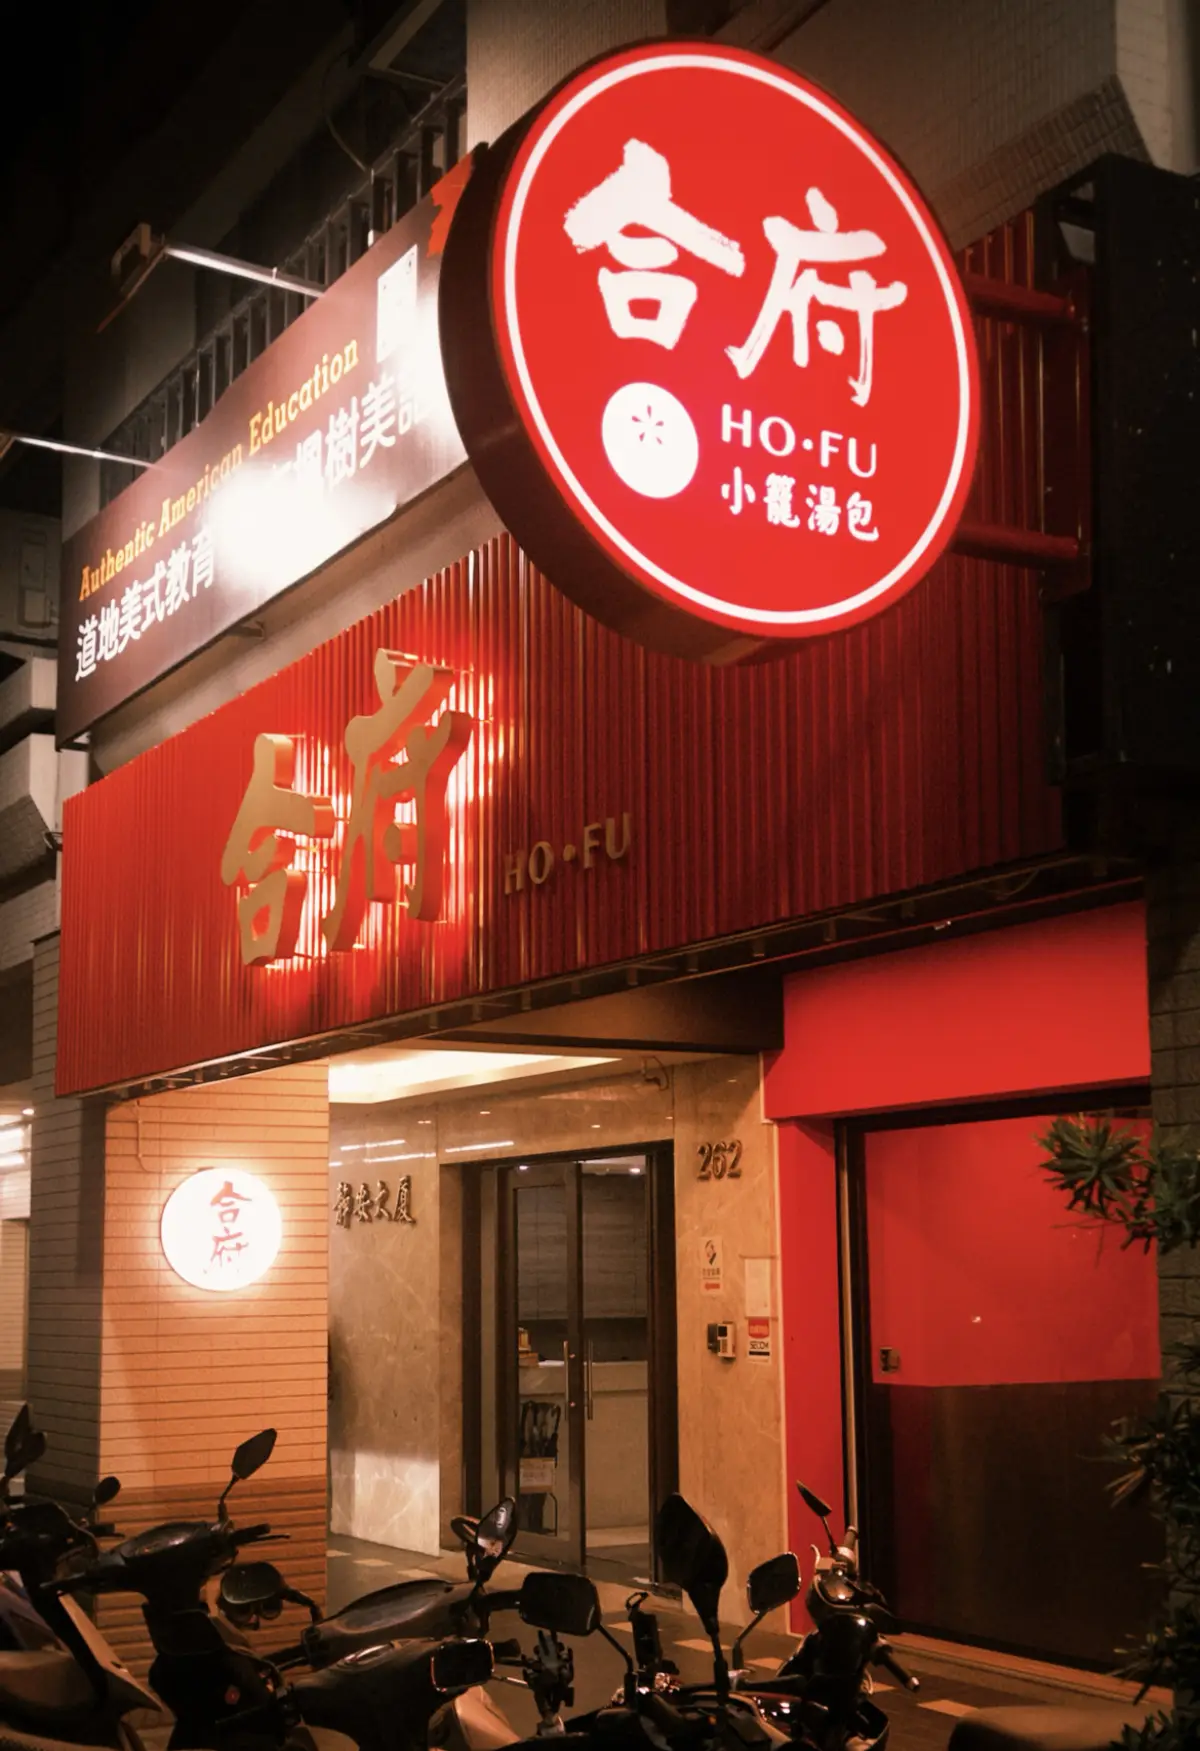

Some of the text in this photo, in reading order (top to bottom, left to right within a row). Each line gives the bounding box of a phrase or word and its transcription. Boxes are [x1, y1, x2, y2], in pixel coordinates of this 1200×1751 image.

[563, 138, 908, 407] 合府
[78, 338, 359, 602] Authentic American Education
[721, 466, 880, 542] 小籠湯包
[75, 525, 215, 682] 道地美式教育
[221, 648, 470, 967] 合府
[203, 1180, 252, 1274] 合府
[697, 1139, 743, 1181] 262
